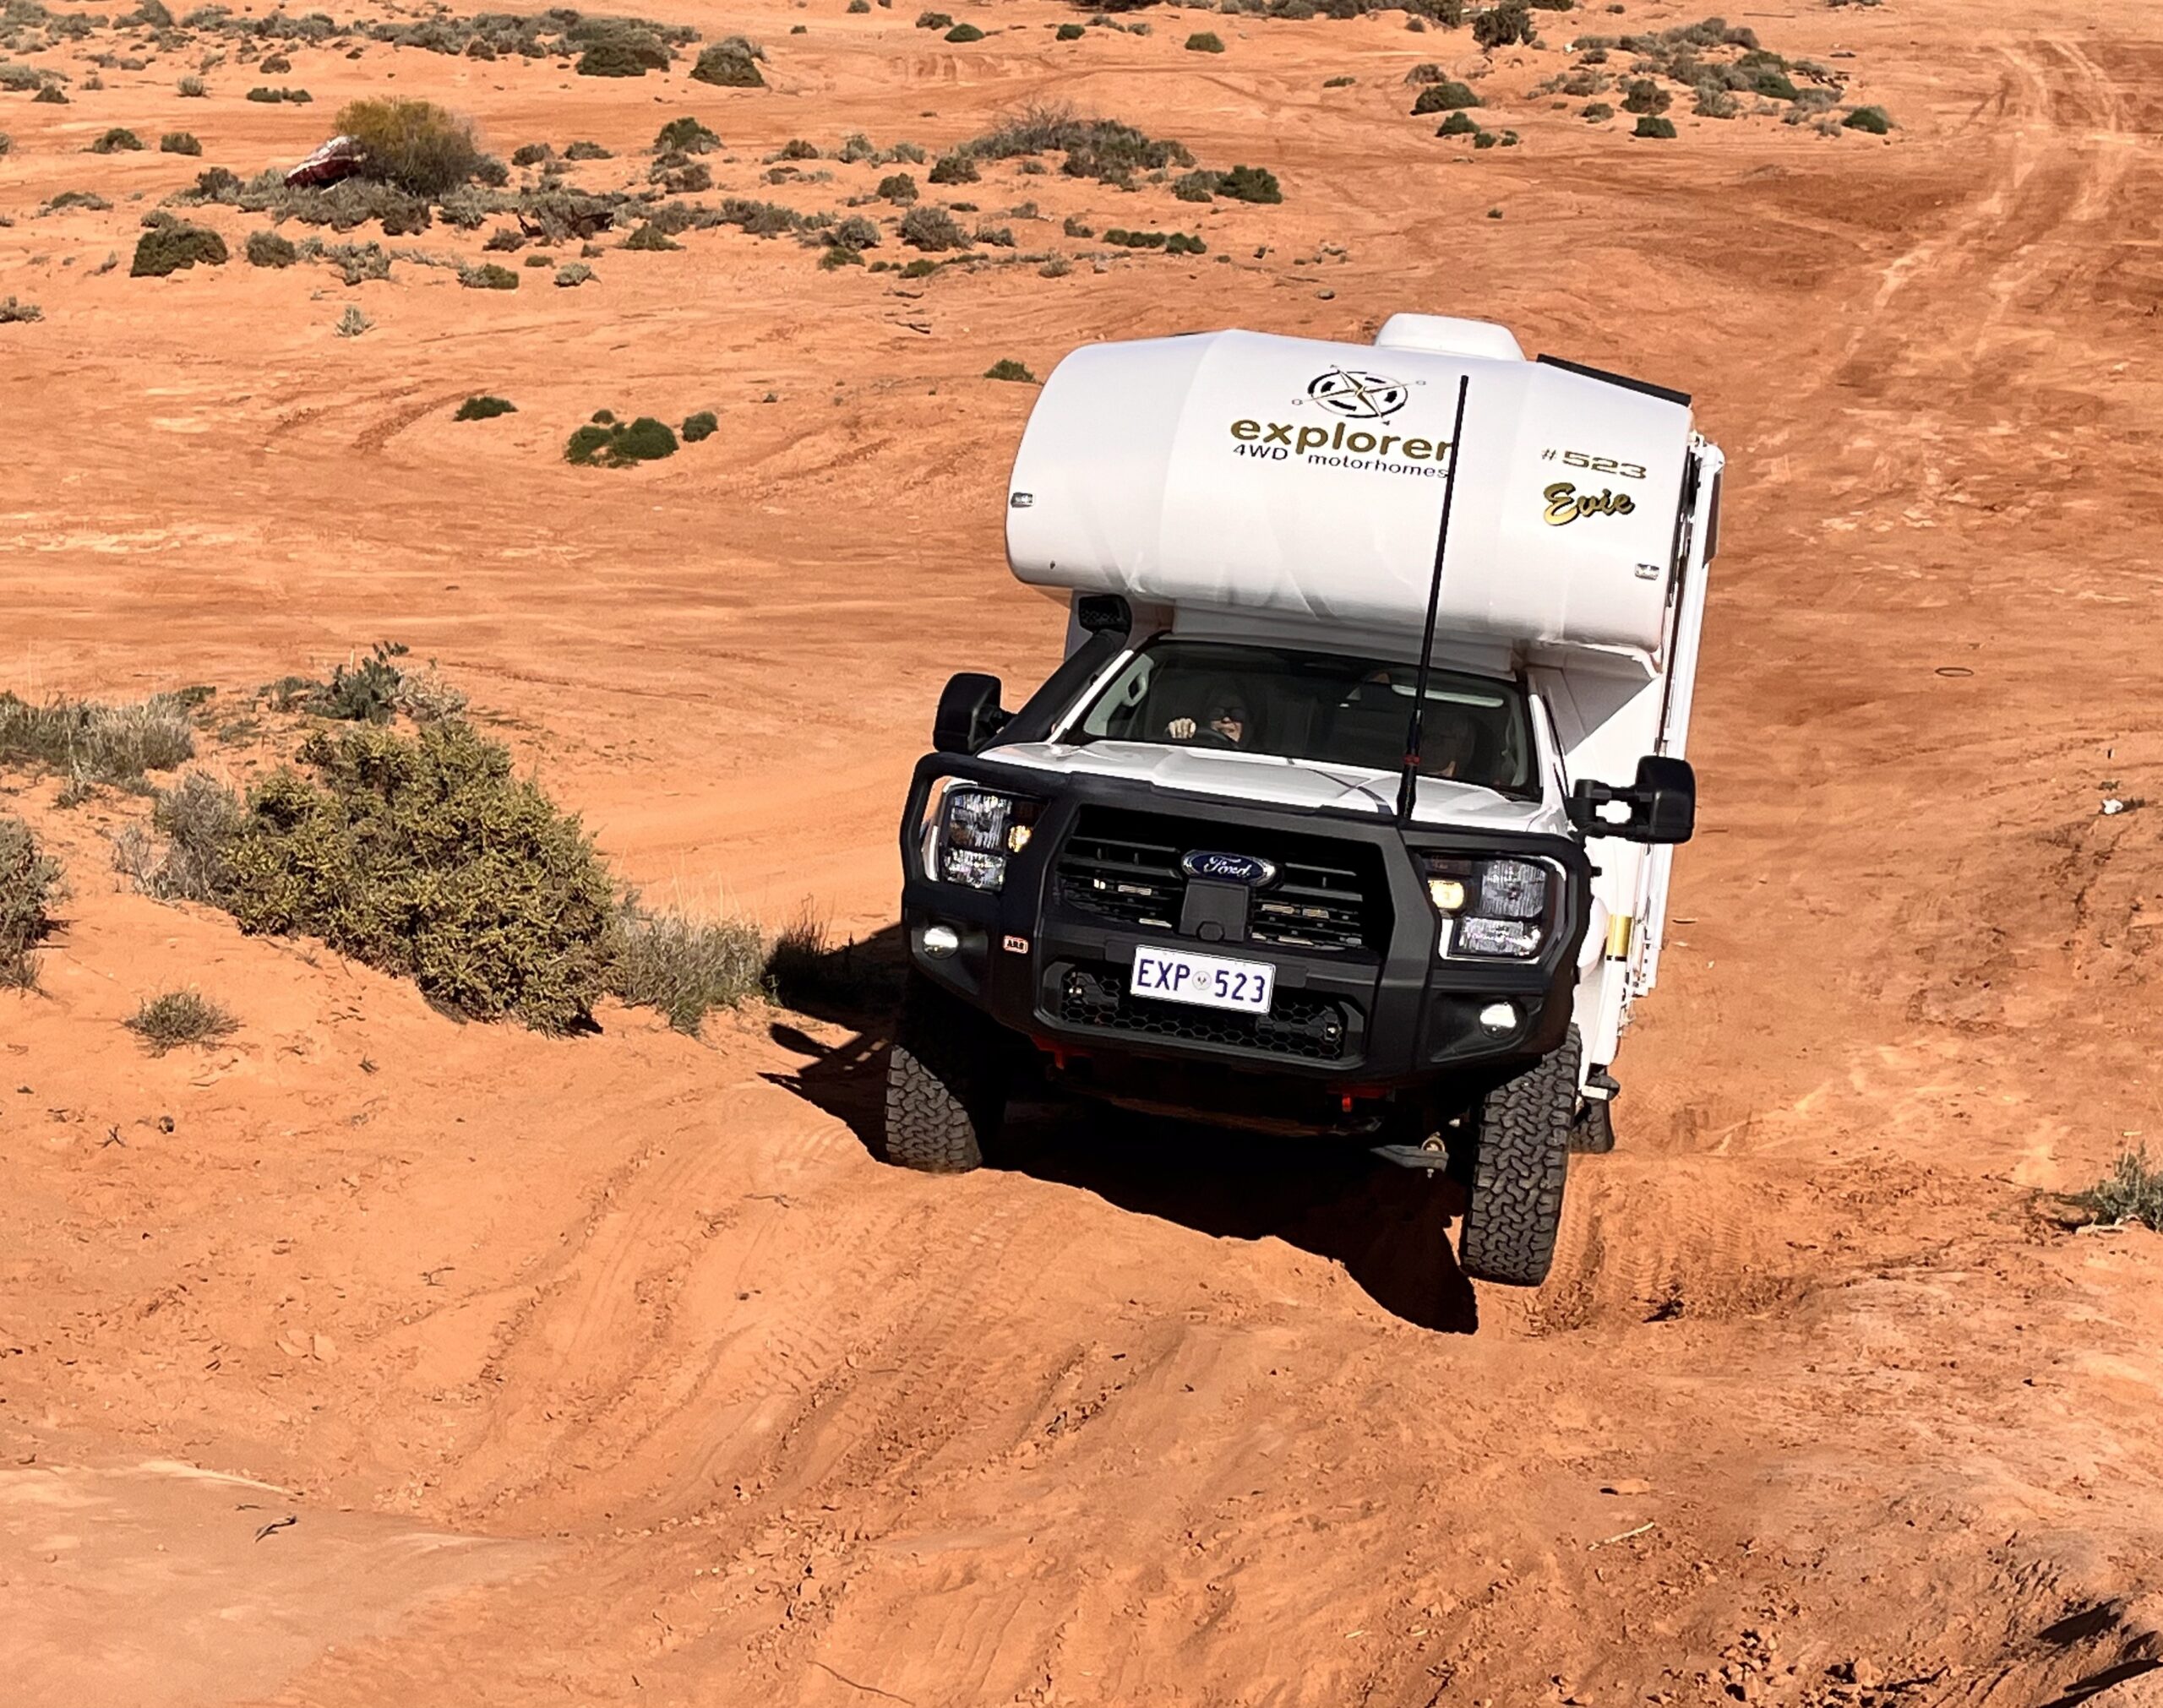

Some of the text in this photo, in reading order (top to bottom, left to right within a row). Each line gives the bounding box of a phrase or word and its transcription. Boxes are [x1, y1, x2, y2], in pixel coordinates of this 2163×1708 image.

[1230, 419, 1453, 461] explorer
[1233, 443, 1449, 479] 4WD motorhomes
[1543, 481, 1636, 527] Evie
[1203, 855, 1250, 878] Ford
[1136, 959, 1267, 1004] EXP 523
